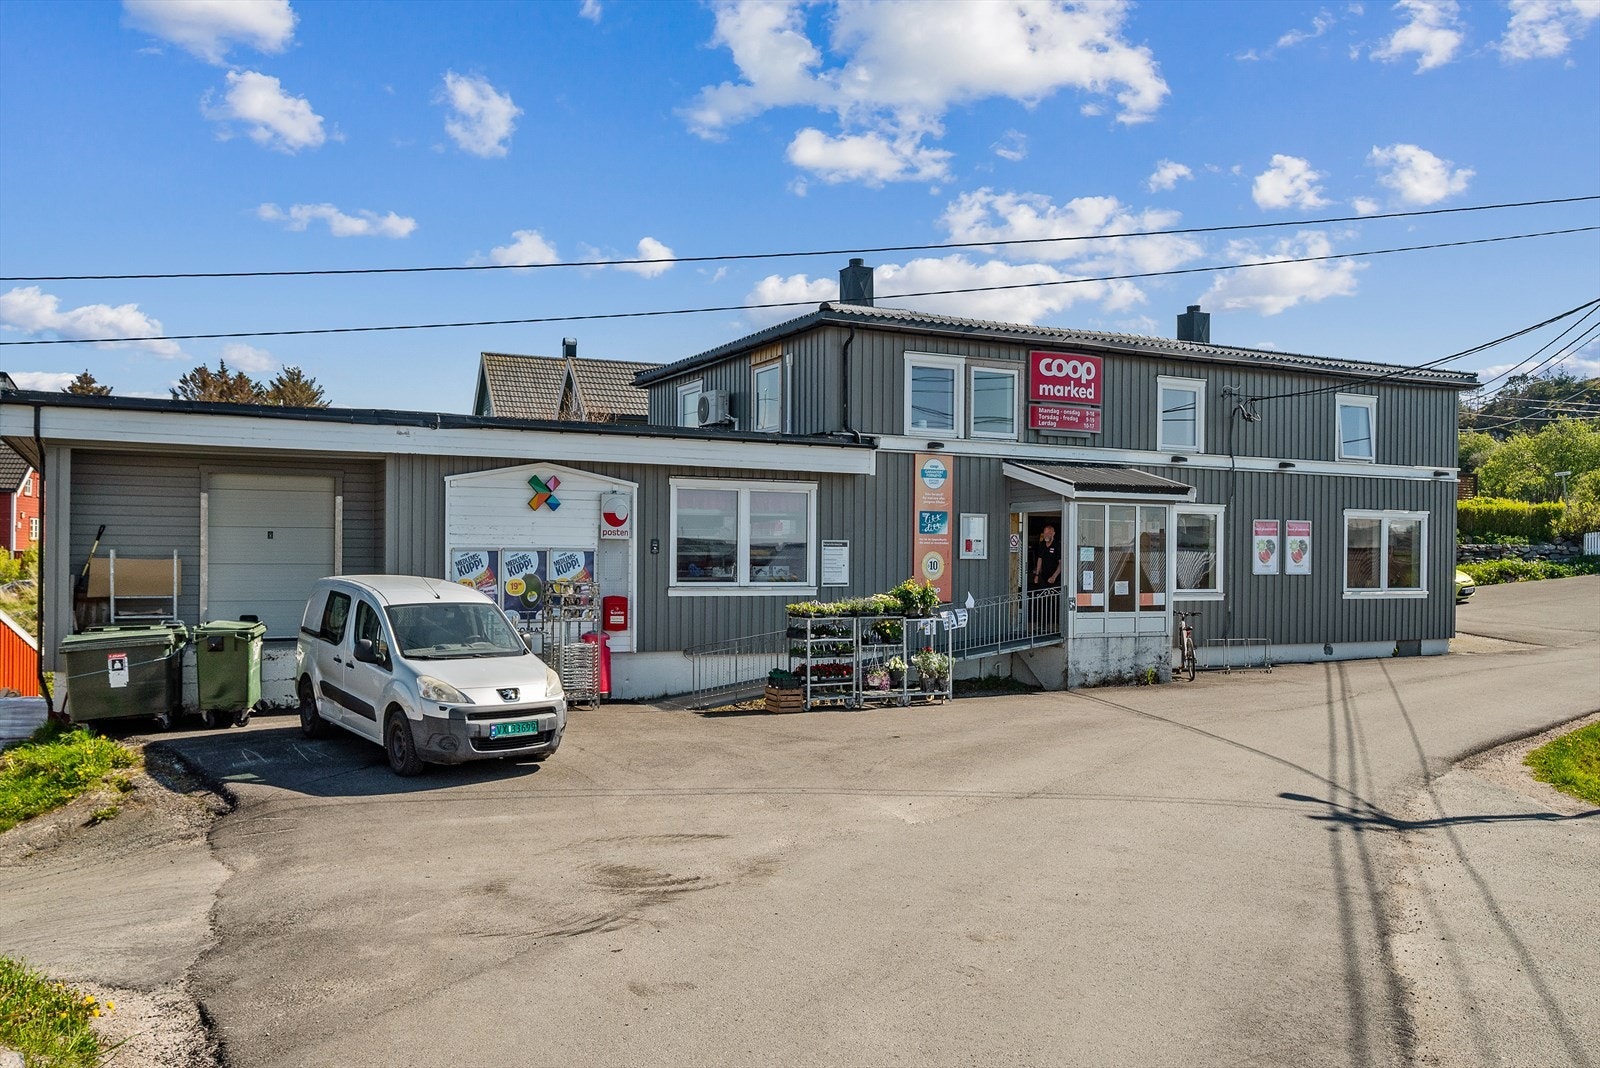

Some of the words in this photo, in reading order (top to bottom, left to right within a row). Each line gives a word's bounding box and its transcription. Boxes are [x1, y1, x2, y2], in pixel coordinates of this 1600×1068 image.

[1039, 358, 1096, 384] coop
[1039, 381, 1095, 399] marked
[1038, 408, 1060, 416] Mandag
[1038, 414, 1060, 422] Torsdag
[602, 529, 629, 537] posten
[457, 558, 484, 577] KUPP!
[507, 558, 534, 577] KUPP!
[555, 558, 580, 576] KUPP!
